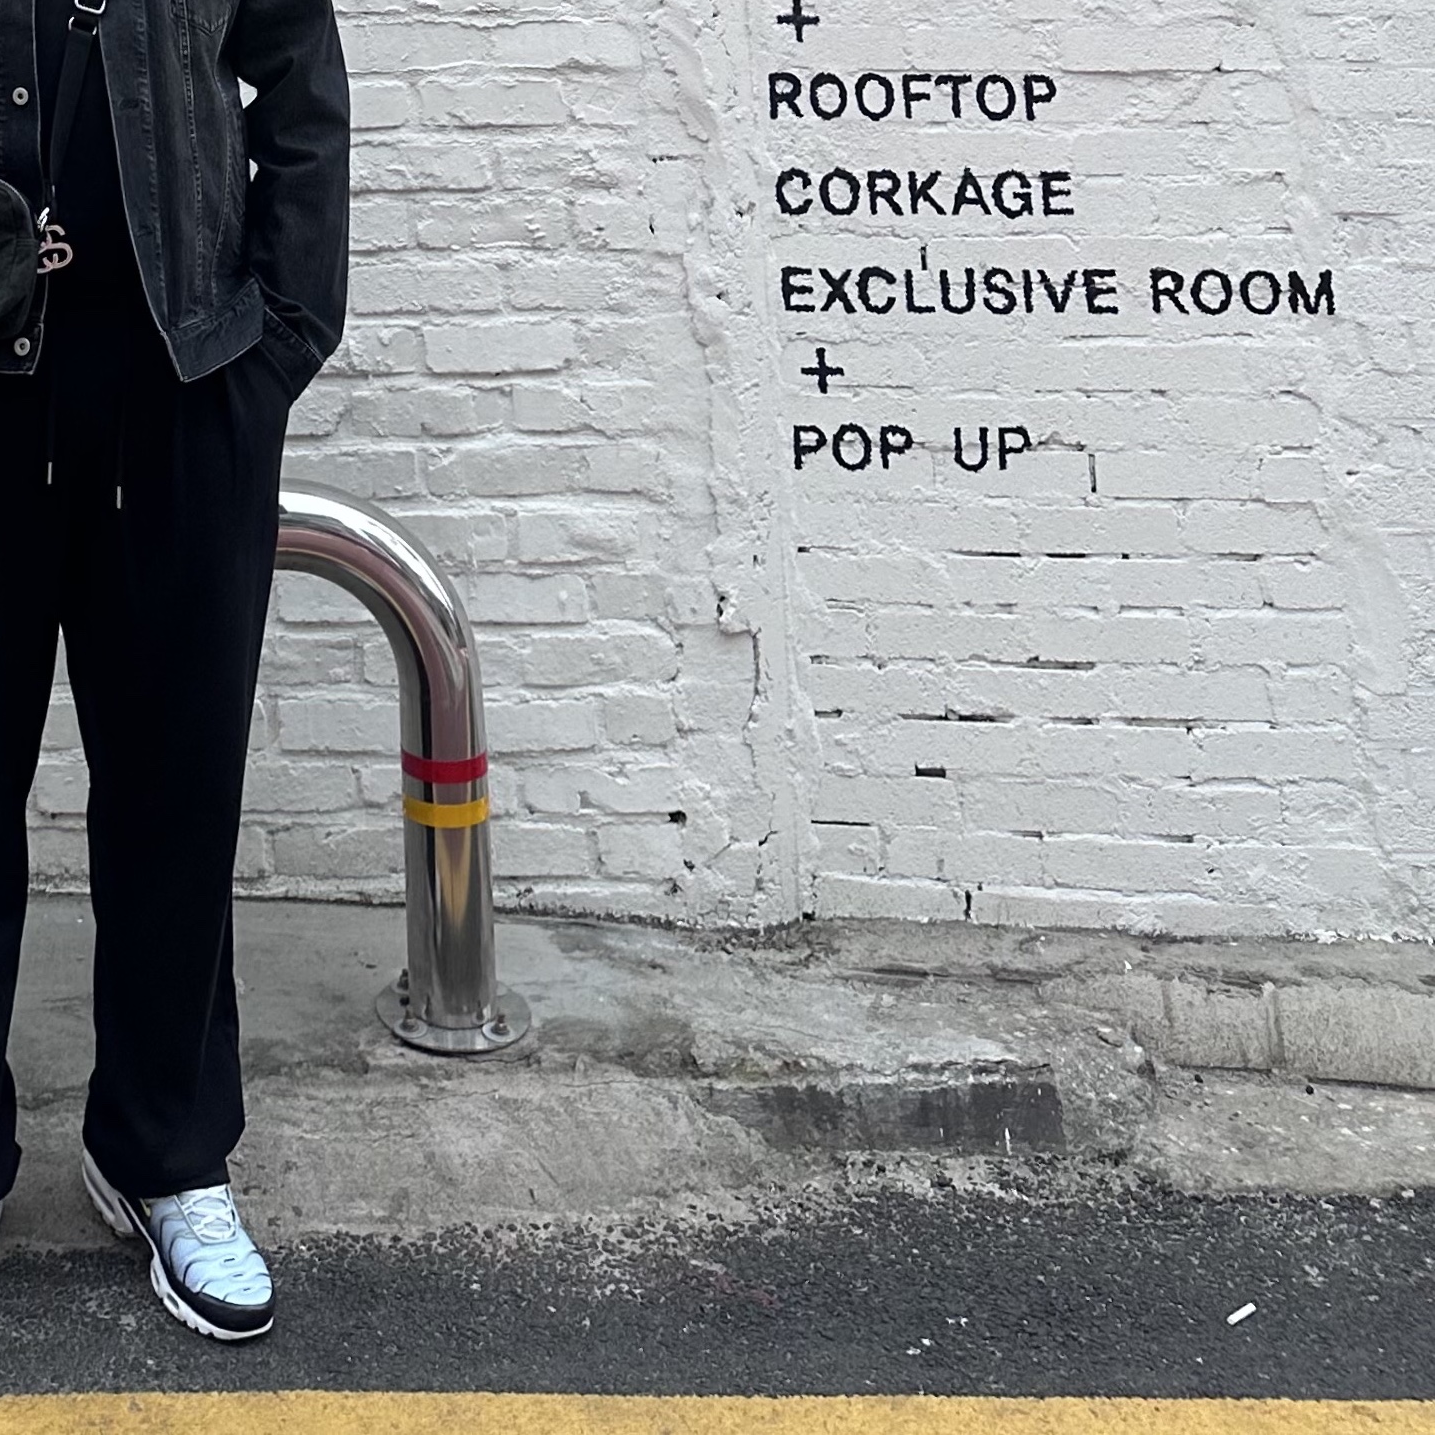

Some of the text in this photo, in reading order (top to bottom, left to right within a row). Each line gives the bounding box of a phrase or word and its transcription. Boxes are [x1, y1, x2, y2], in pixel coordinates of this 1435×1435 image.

[768, 71, 1057, 122] ROOFTOP
[775, 166, 1075, 220] CORKAGE
[780, 265, 1336, 316] EXCLUSIVE ROOM
[793, 422, 1034, 473] POP UP
